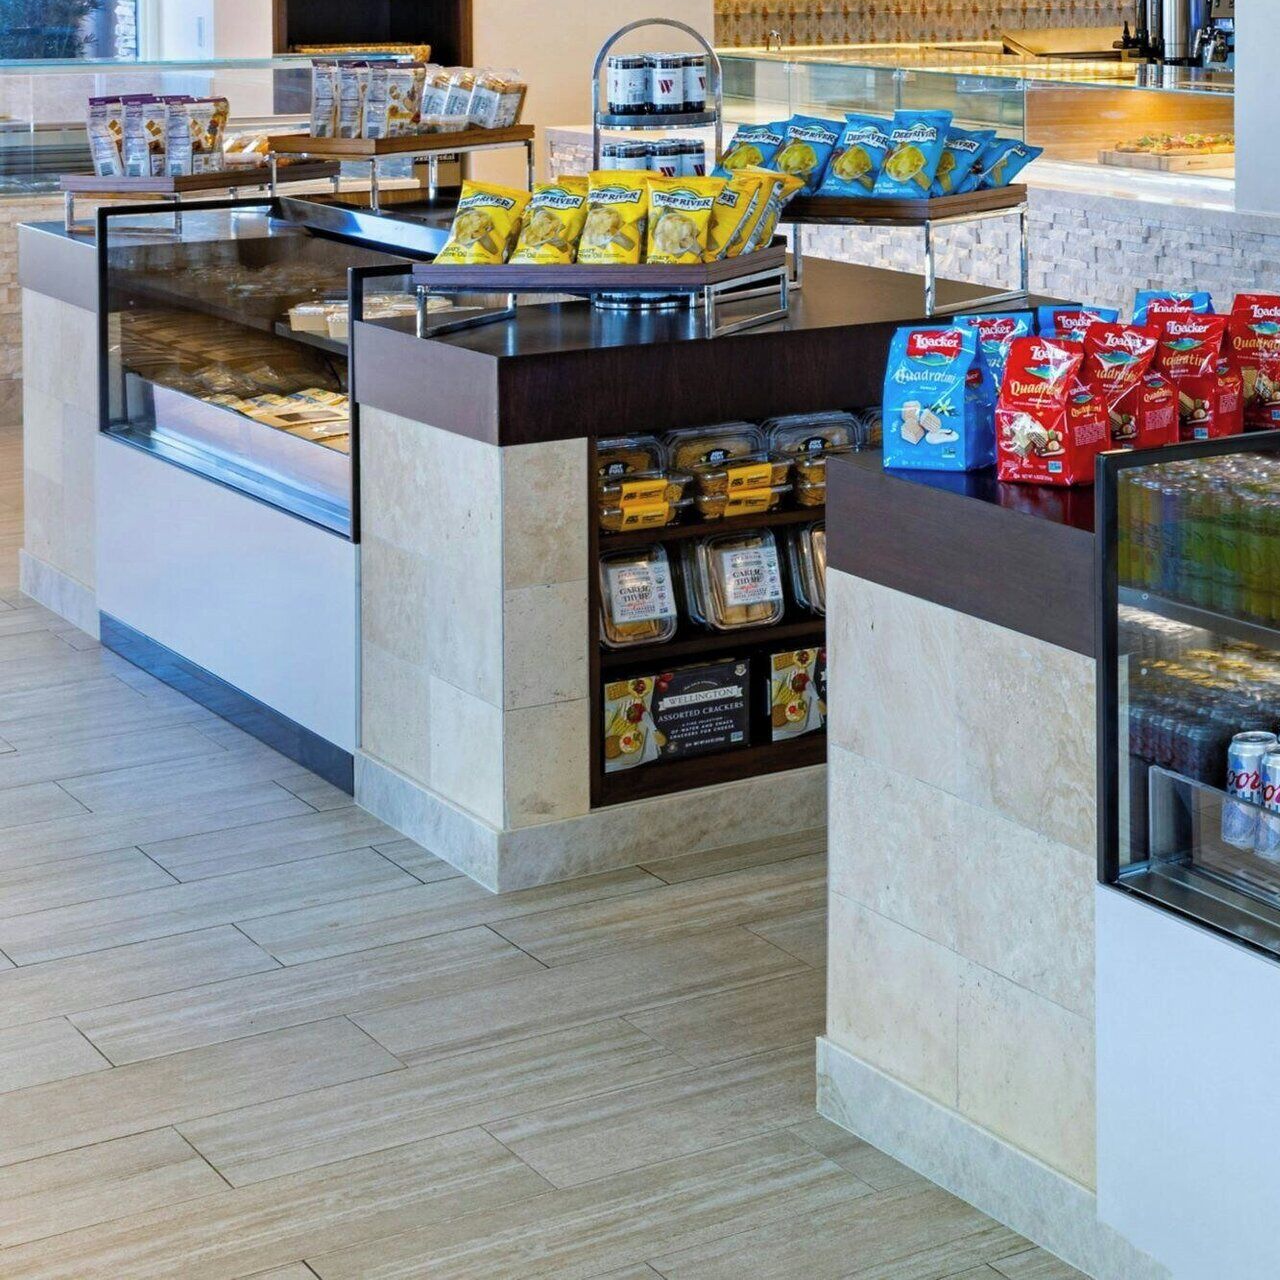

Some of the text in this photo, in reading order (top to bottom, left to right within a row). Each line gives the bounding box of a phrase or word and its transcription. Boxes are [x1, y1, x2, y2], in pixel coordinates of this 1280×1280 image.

[893, 130, 912, 139] DEEP
[609, 191, 638, 201] RIVER
[680, 197, 712, 207] RIVER
[1167, 321, 1209, 333] Loacker
[913, 334, 958, 347] Loacker
[669, 688, 735, 705] WELLINGTON
[658, 701, 744, 722] ASSORTED CRACKERS
